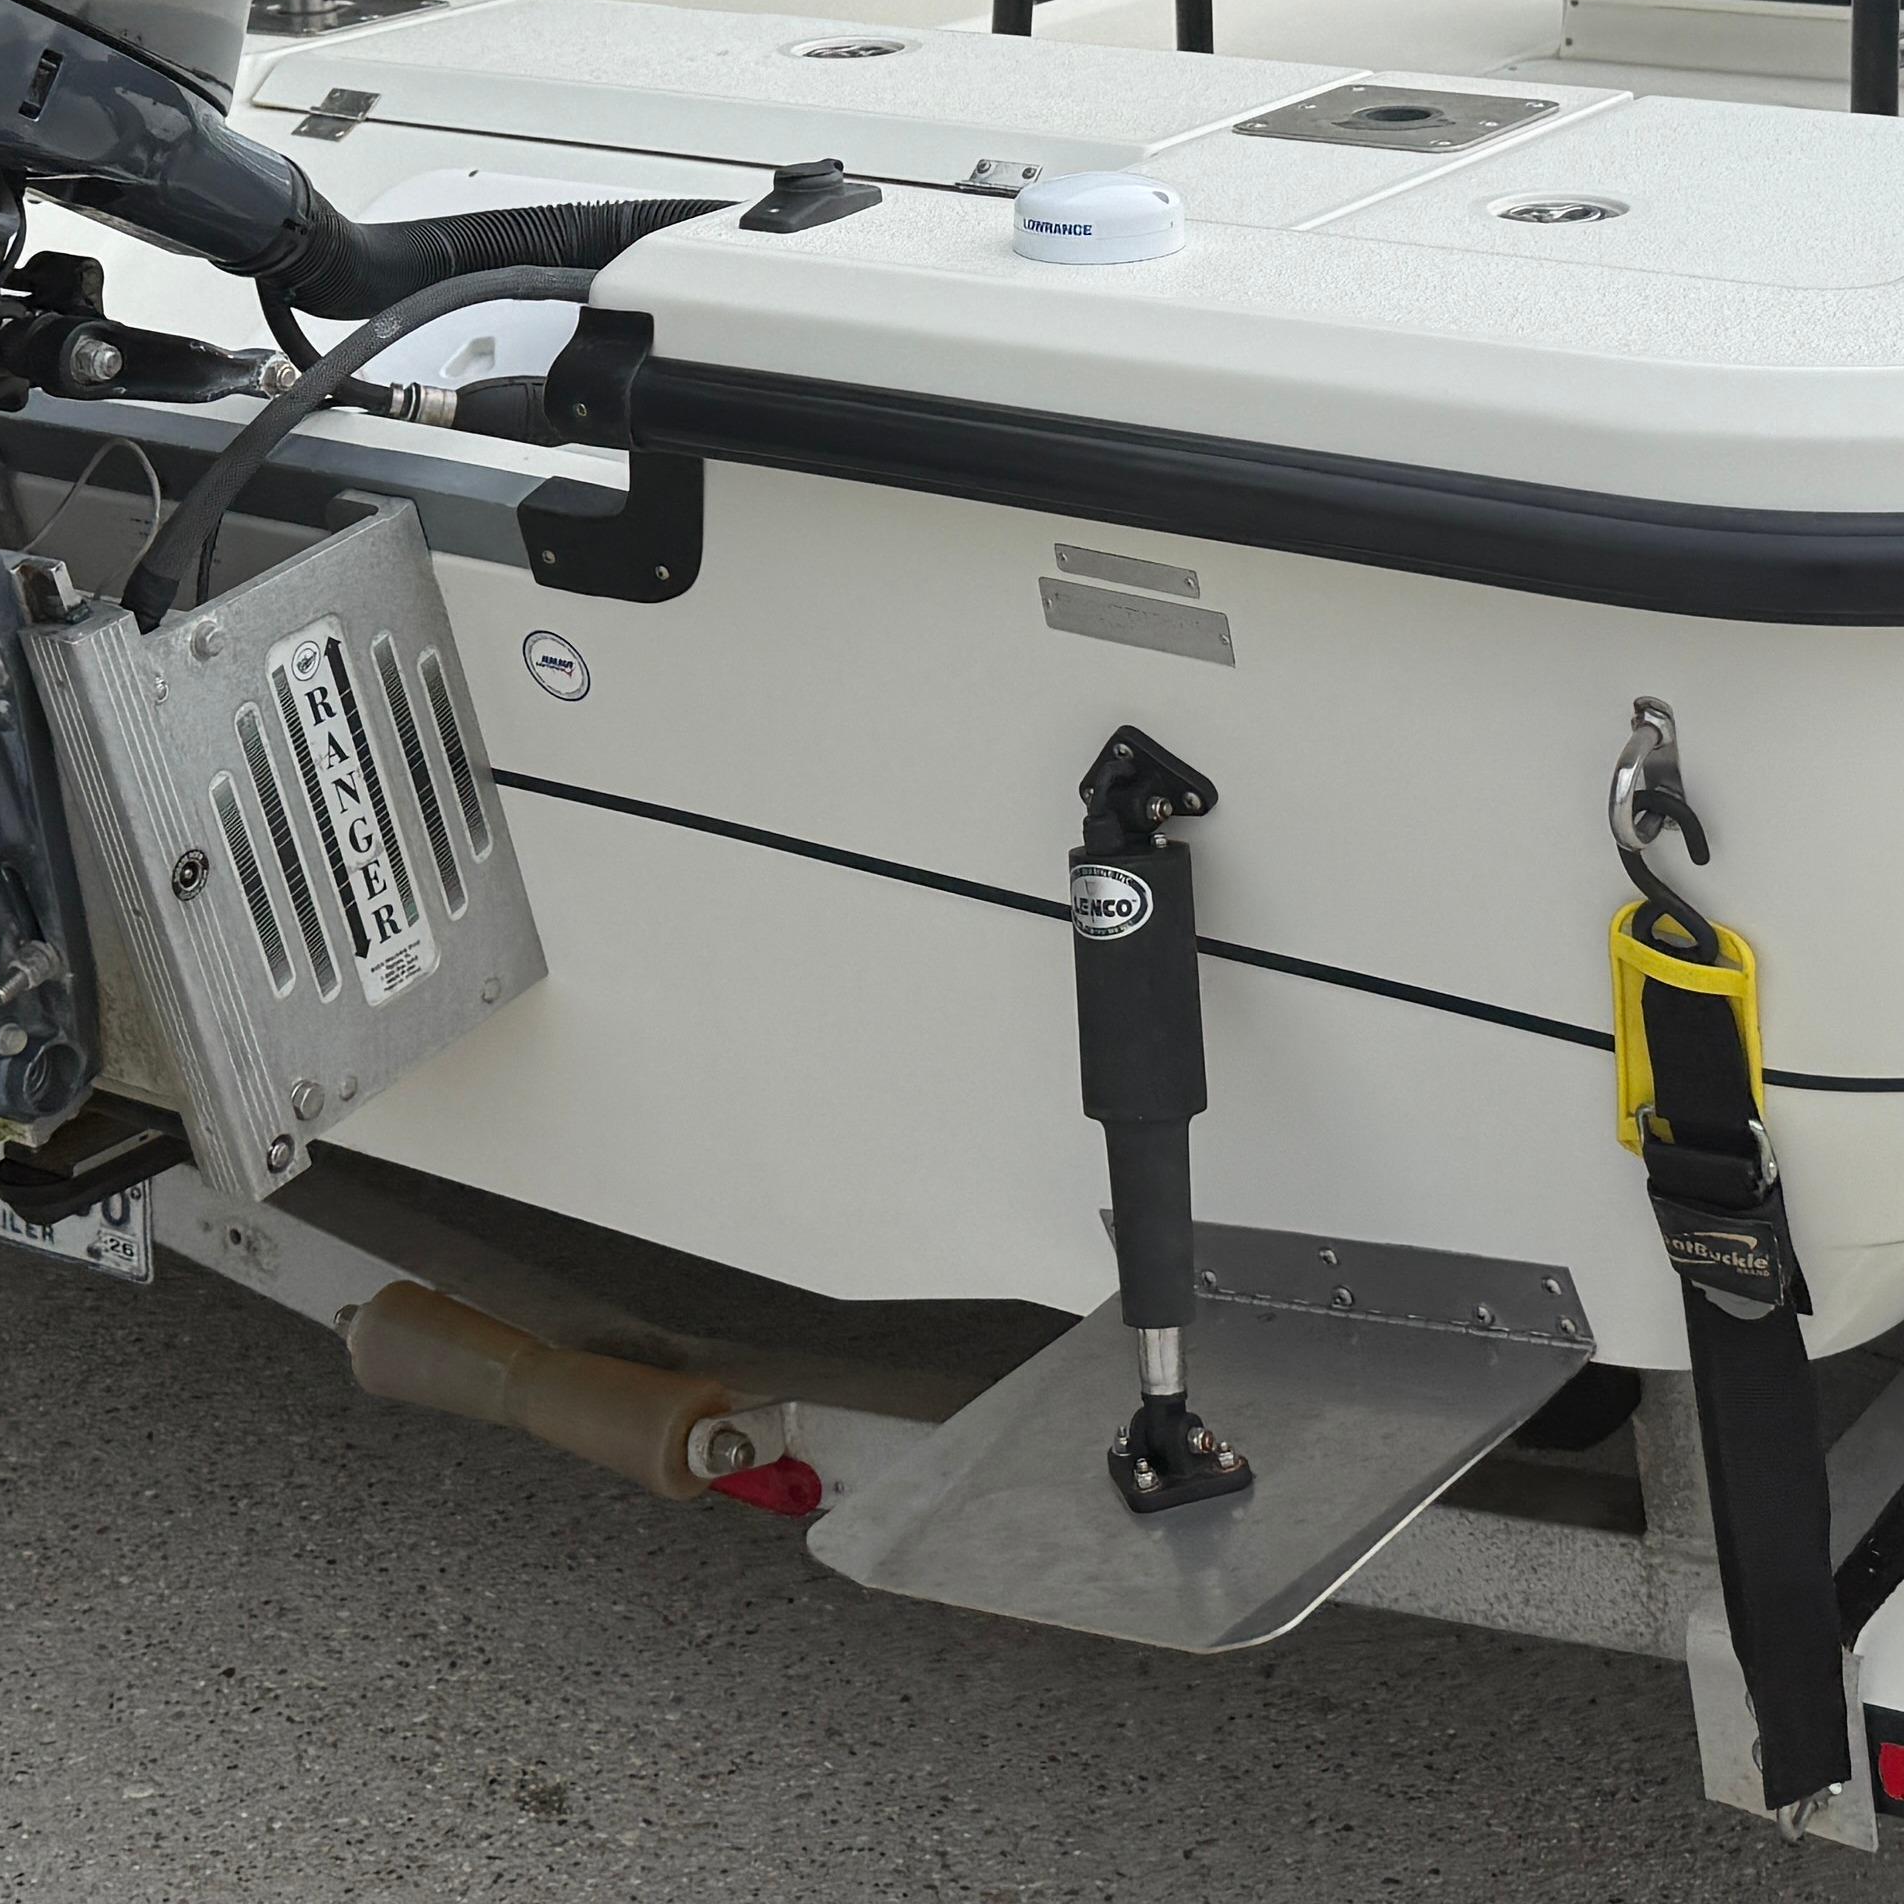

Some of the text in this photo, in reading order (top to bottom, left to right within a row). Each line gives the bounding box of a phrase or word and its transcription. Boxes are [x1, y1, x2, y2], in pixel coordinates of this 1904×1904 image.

[1023, 217, 1093, 237] LOWRANCE
[304, 685, 403, 944] RANGER
[1073, 895, 1133, 918] LENCO
[1665, 1236, 1770, 1270] atBuckle
